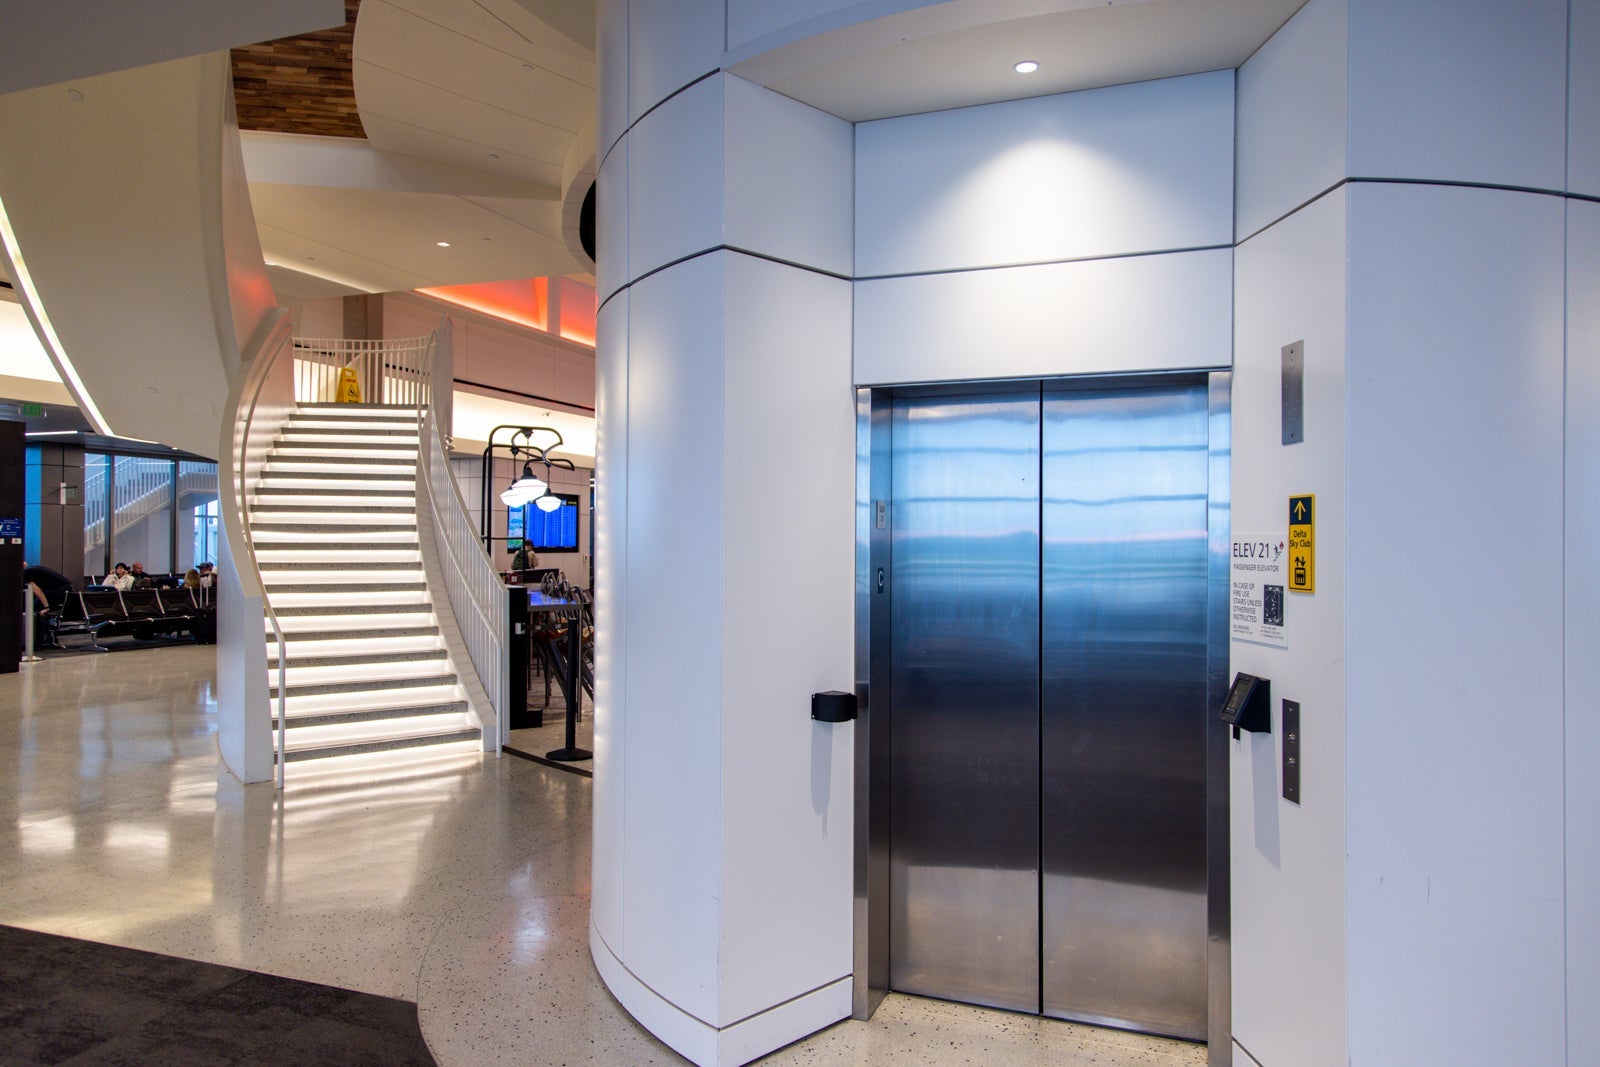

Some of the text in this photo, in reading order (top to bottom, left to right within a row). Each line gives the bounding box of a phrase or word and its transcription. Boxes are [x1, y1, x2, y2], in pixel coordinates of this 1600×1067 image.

[1294, 530, 1307, 538] Delta
[1289, 540, 1311, 549] Sky Club
[1233, 542, 1270, 558] ELEV 21
[1233, 563, 1279, 572] PASSENGER ELEVATOR
[1238, 582, 1249, 590] CASE
[1233, 589, 1250, 598] FIRE USE
[1233, 598, 1262, 607] STAIRS UNLESS
[1233, 606, 1256, 614] OTHERWISE
[1233, 614, 1257, 622] INSTRUCTED
